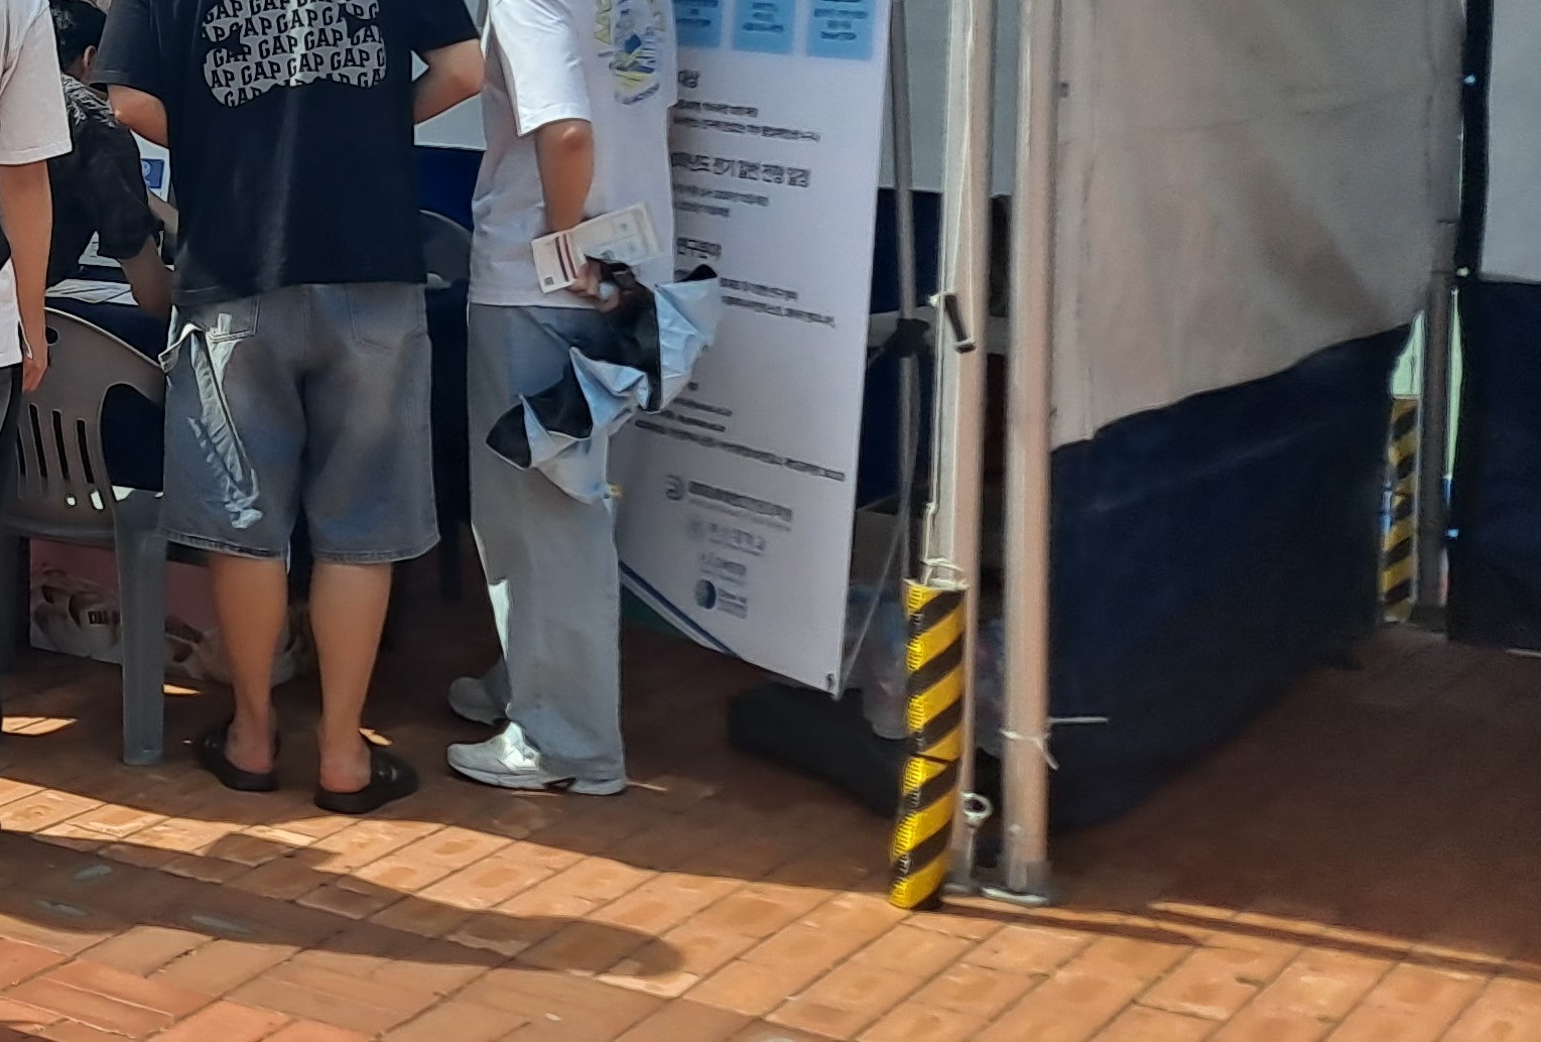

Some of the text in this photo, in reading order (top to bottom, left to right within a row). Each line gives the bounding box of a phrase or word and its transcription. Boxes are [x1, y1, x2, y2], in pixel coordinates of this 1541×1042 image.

[276, 9, 319, 34] GAP
[258, 35, 299, 60] GAP
[304, 27, 344, 51] GAP
[241, 60, 282, 86] GAP
[286, 52, 325, 78] GAP
[330, 47, 371, 71] GAP
